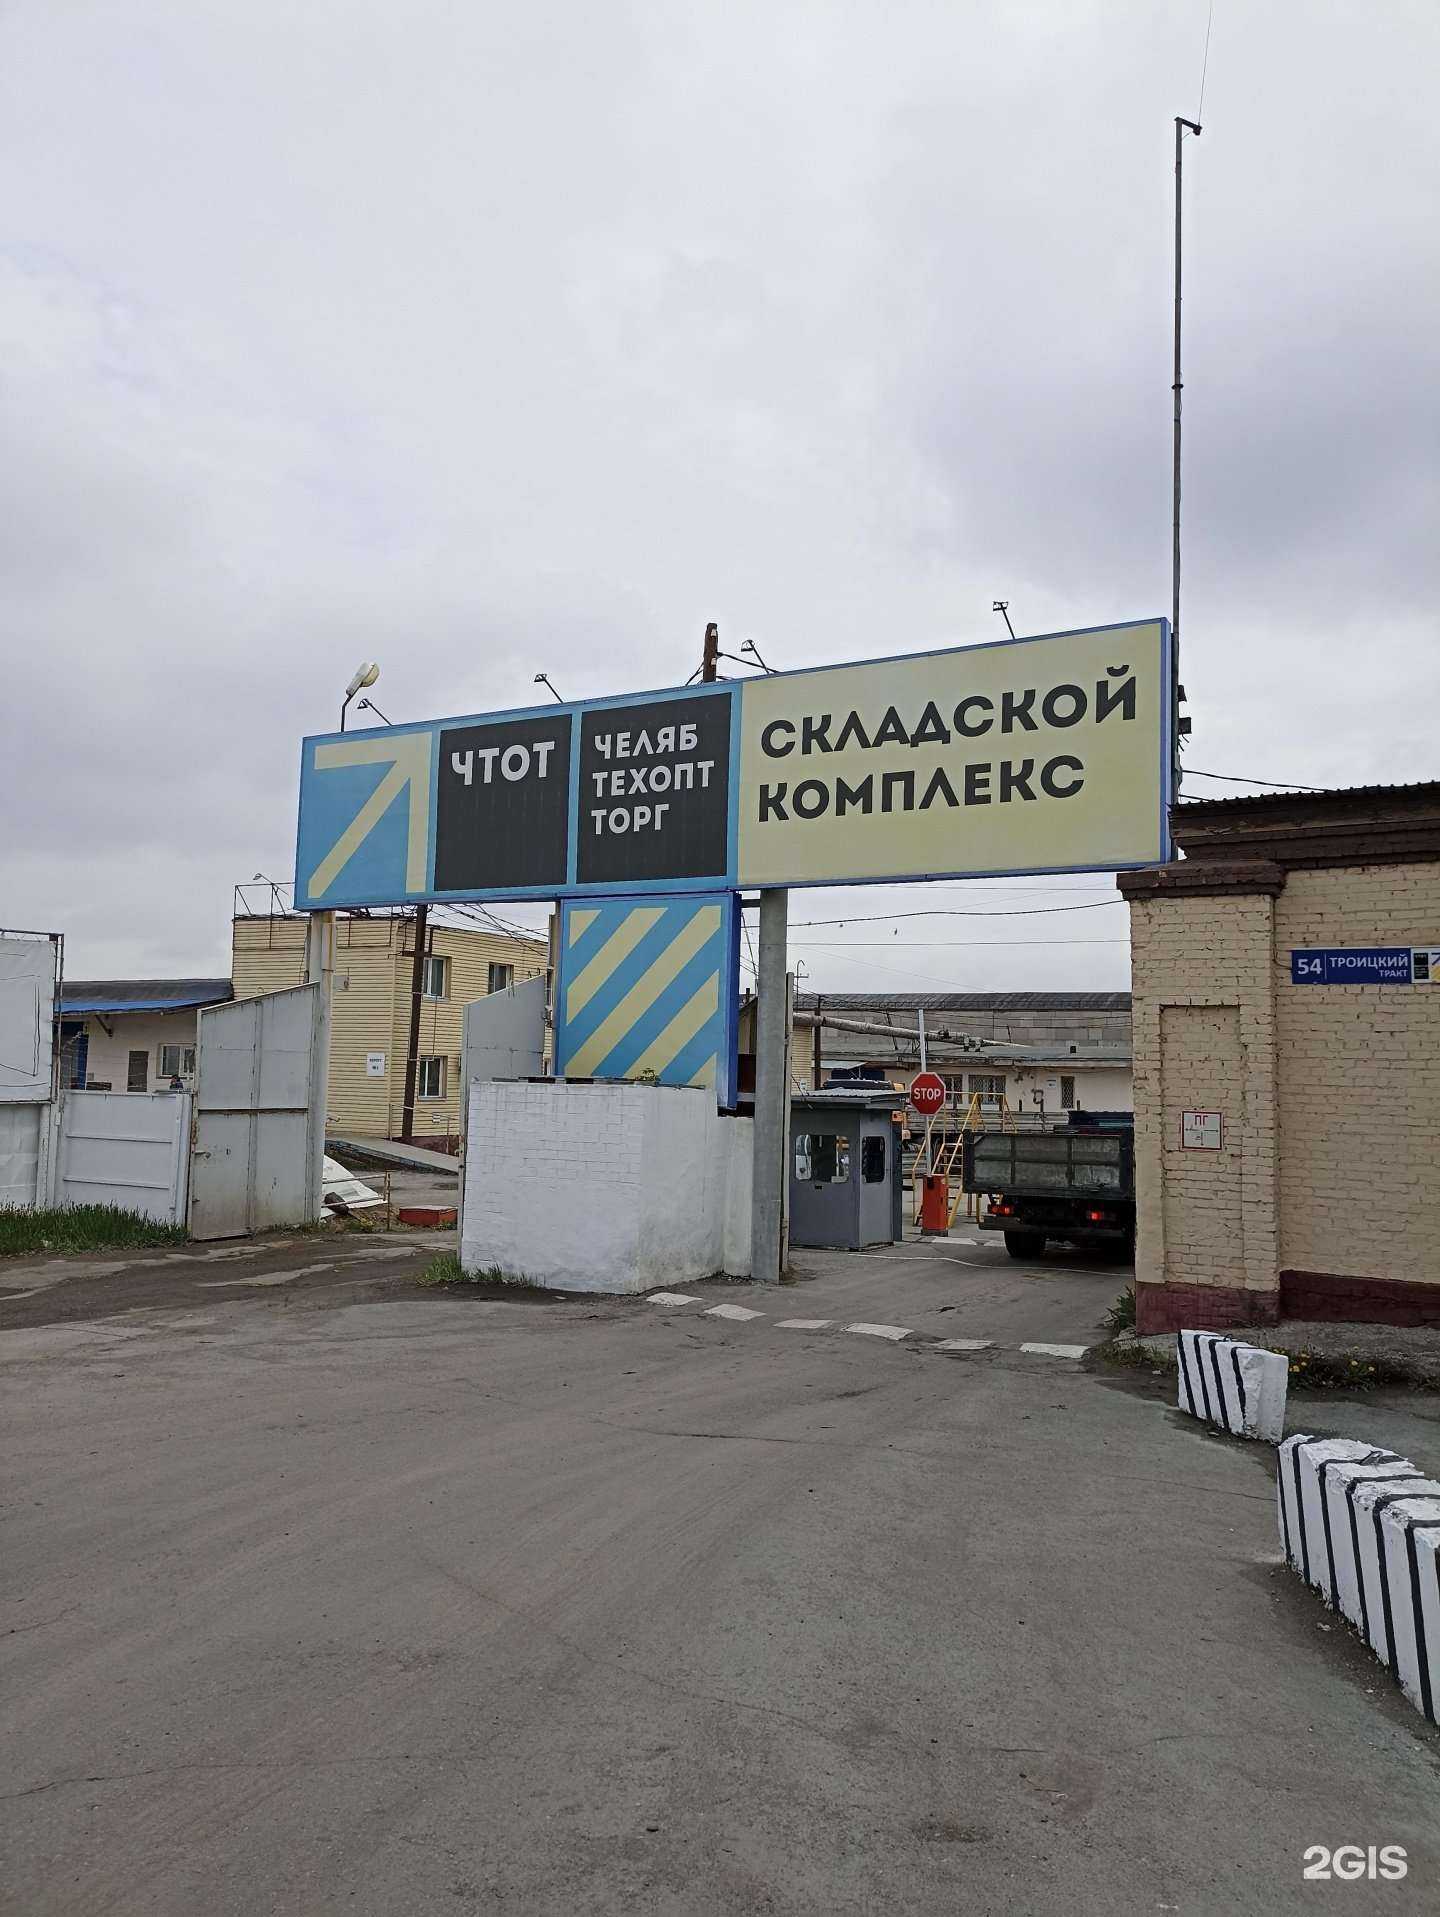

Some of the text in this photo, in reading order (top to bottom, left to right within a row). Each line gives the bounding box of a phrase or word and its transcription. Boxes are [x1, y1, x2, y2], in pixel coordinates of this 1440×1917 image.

[761, 664, 1137, 759] СКЛАДСКОЙ
[594, 723, 698, 760] ЧЕЛЯБ
[451, 740, 556, 786] ЧТОТ
[592, 760, 715, 798] ТЕХОПТ
[758, 754, 1085, 823] КОМПЛЕКС
[590, 803, 670, 835] ТОРГ
[1297, 958, 1323, 975] 54
[1329, 953, 1408, 969] ТРОИЦКИЙ
[1379, 969, 1408, 977] ТРАКТ
[913, 1087, 941, 1100] STOP
